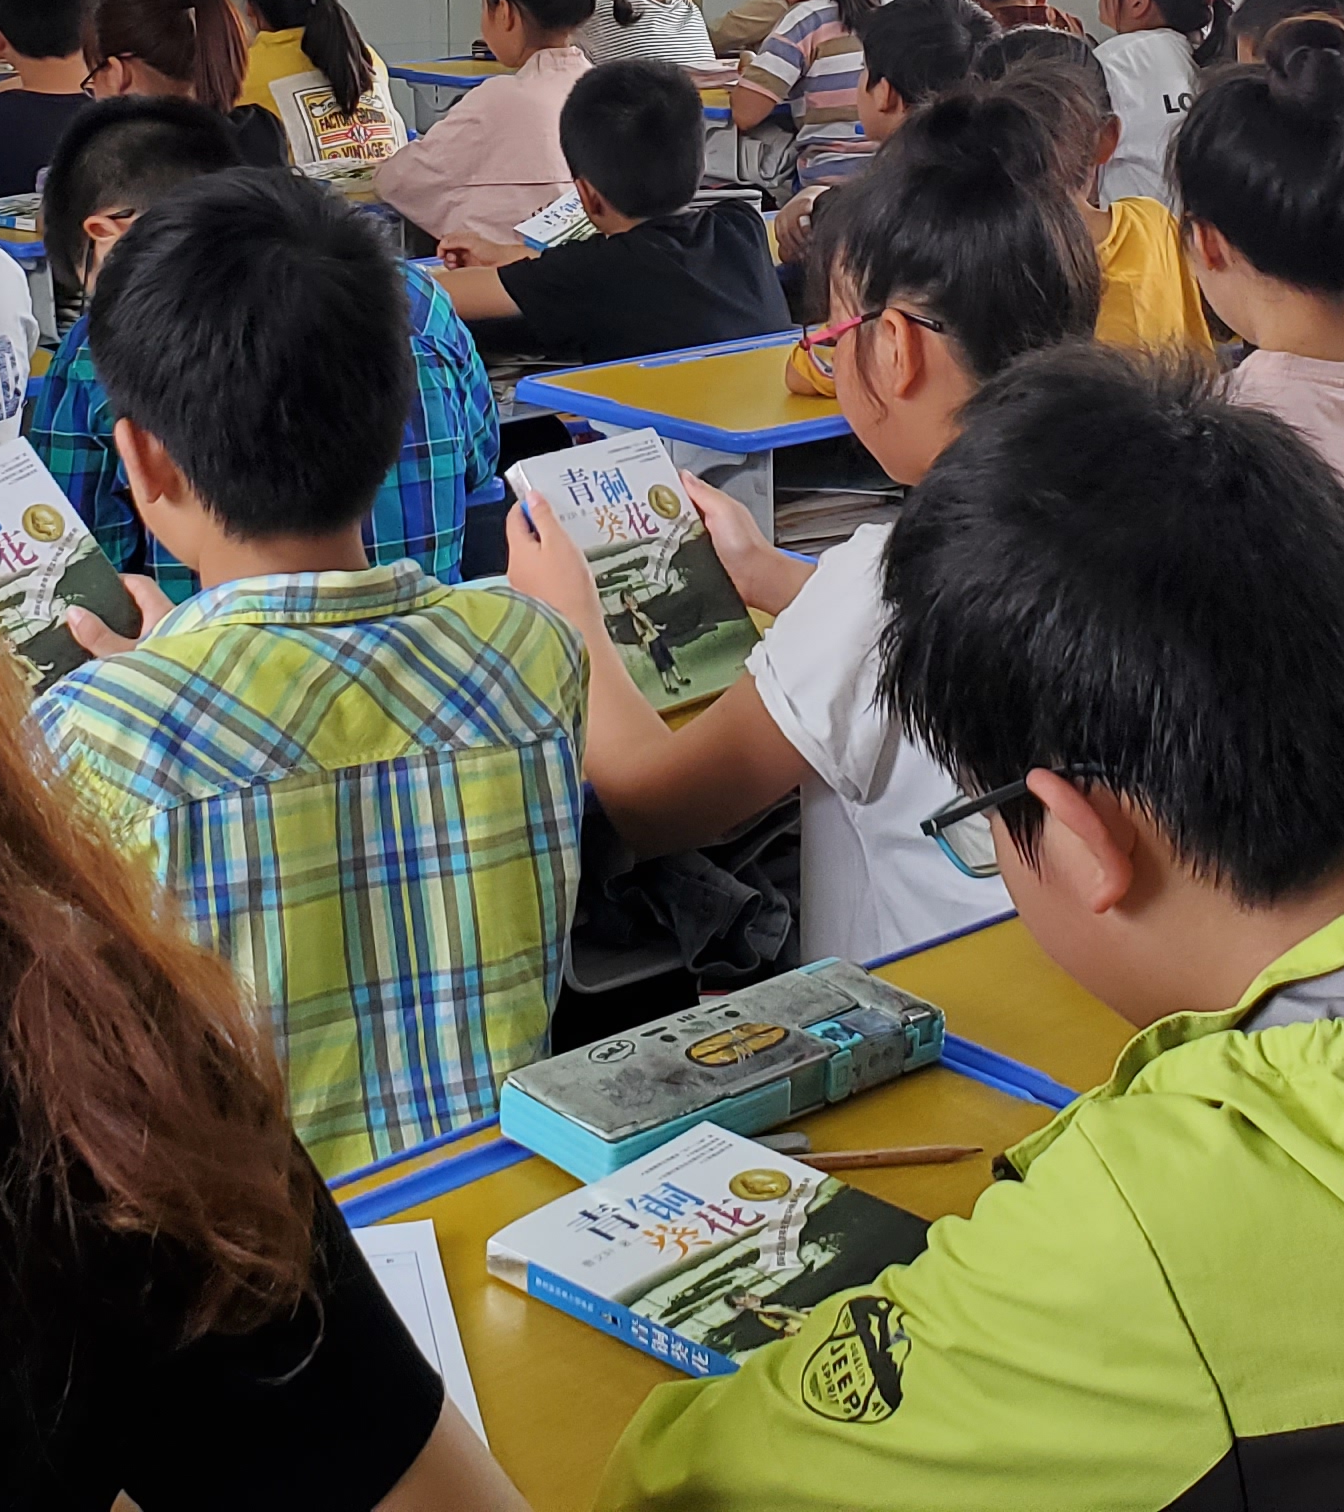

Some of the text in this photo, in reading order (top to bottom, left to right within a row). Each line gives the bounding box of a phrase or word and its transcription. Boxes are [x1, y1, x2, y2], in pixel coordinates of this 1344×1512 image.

[559, 467, 633, 507] 青铜
[593, 501, 660, 544] 葵花
[567, 1181, 706, 1241] 青铜
[642, 1198, 766, 1261] 葵花
[830, 1342, 861, 1409] JEEP
